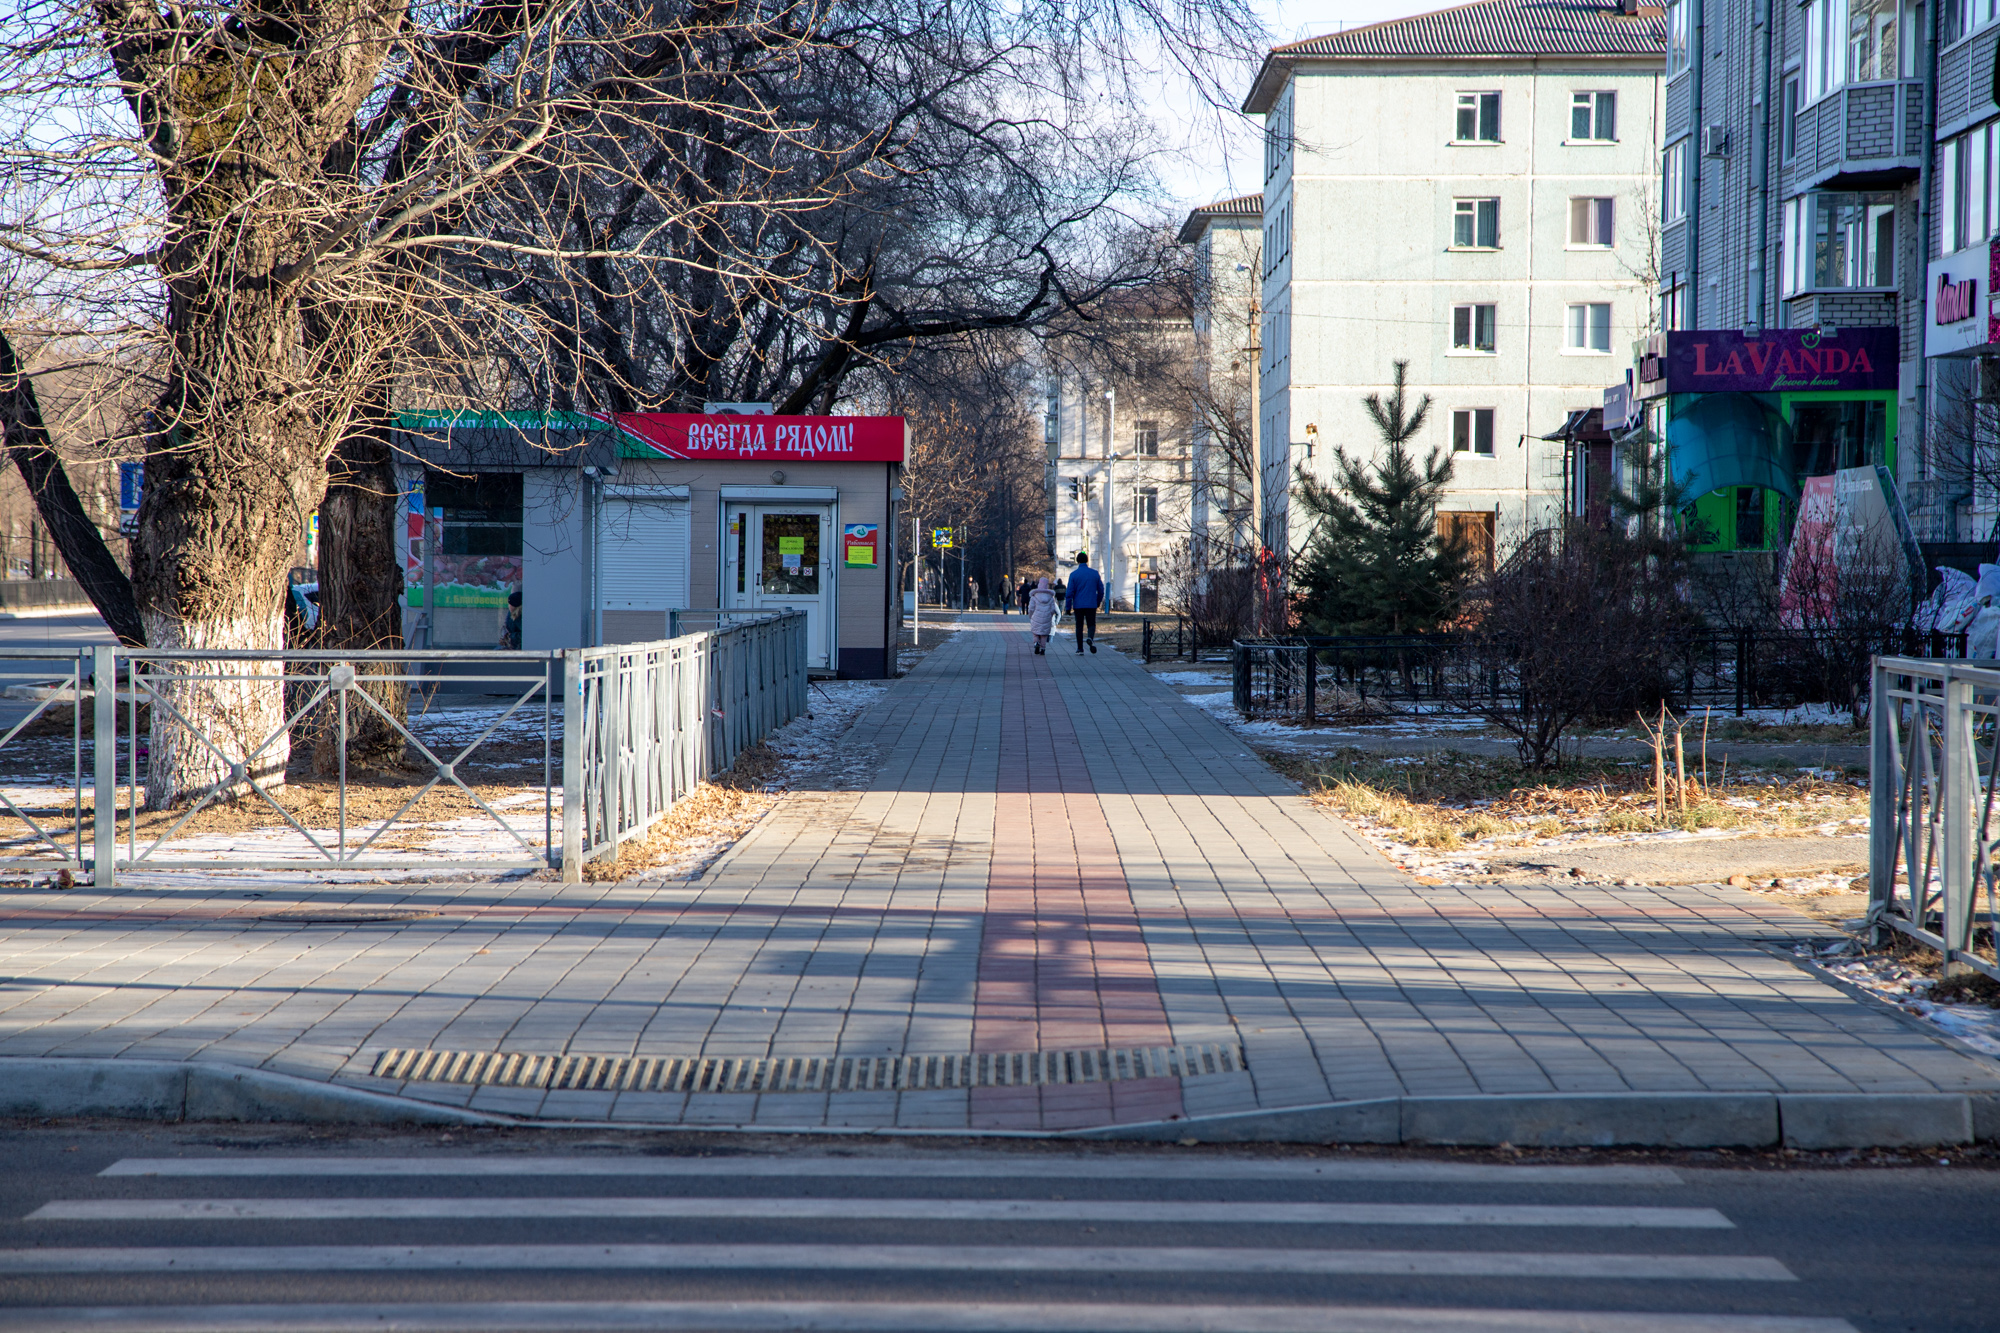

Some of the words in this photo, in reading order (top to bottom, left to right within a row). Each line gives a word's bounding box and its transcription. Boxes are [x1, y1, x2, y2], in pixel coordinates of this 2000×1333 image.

[1770, 374, 1808, 390] flower
[1809, 374, 1839, 386] house
[686, 423, 768, 457] ВСЕГДА
[773, 422, 854, 458] РЯДОМ!
